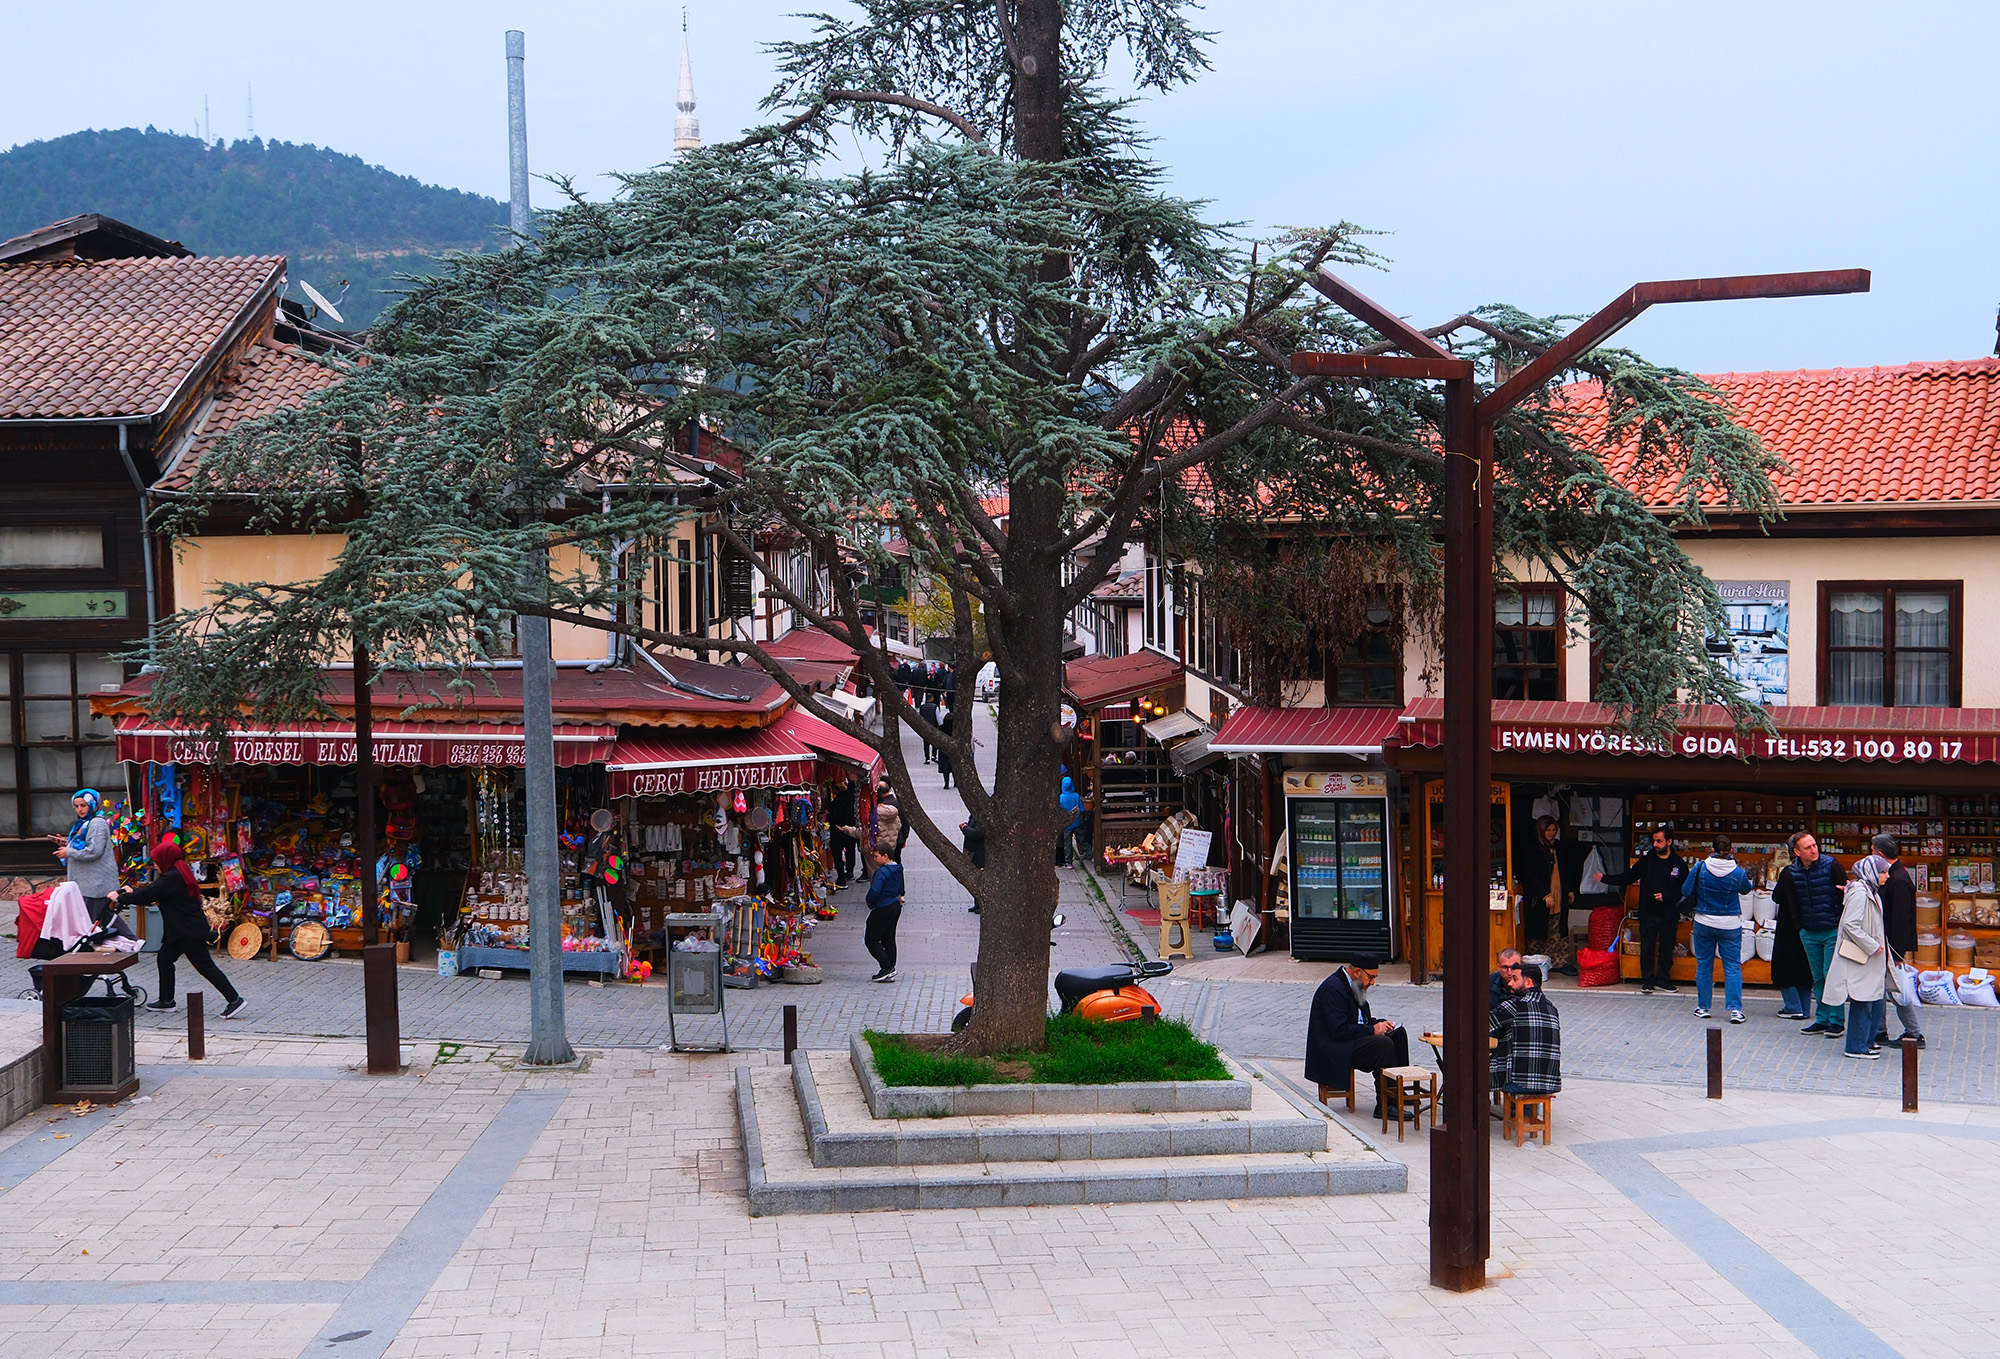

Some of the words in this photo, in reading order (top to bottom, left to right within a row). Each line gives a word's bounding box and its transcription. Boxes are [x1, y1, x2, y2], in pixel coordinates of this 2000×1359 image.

[1755, 582, 1786, 598] Han
[233, 738, 302, 762] YÖRESEL
[317, 742, 337, 762] EL
[340, 742, 423, 763] SAATLARI
[451, 744, 480, 755] 0537
[482, 744, 504, 755] 957
[1502, 731, 1570, 749] EYMEN
[1682, 736, 1737, 754] GIDA
[1764, 738, 1846, 756] TEL:532
[1853, 740, 1895, 758] 100
[1903, 740, 1933, 758] 80
[1940, 741, 1963, 759] 17
[450, 754, 479, 764] 0546
[481, 754, 503, 764] 420
[633, 768, 685, 797] ÇERÇİ
[697, 762, 788, 789] HEDİYELİK
